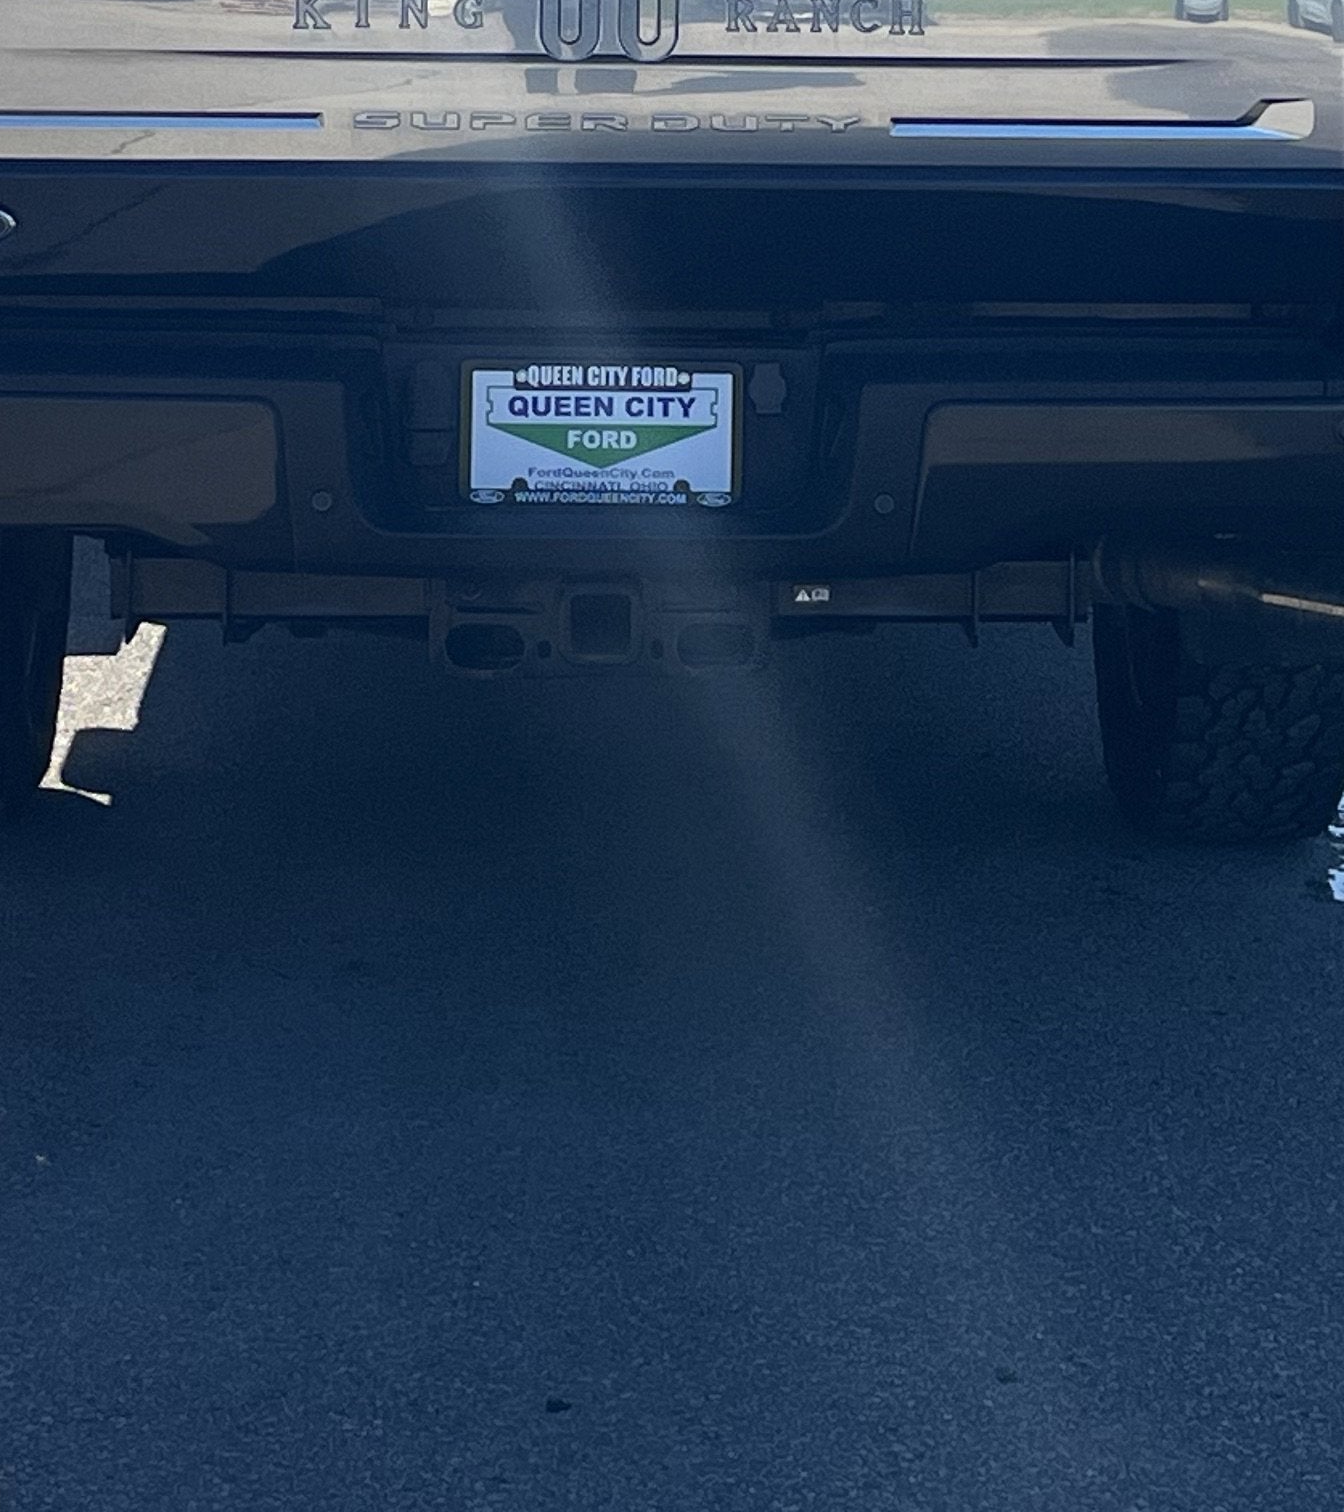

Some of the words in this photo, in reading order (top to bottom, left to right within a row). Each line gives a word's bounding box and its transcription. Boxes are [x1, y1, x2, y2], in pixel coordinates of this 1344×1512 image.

[353, 110, 629, 133] SUPER
[651, 113, 861, 134] DUTY
[528, 364, 583, 388] QUEEN
[587, 365, 629, 387] CITY
[632, 366, 678, 388] FORD
[508, 395, 614, 418] QUEEN
[624, 396, 696, 418] CITY
[566, 429, 638, 450] FORD
